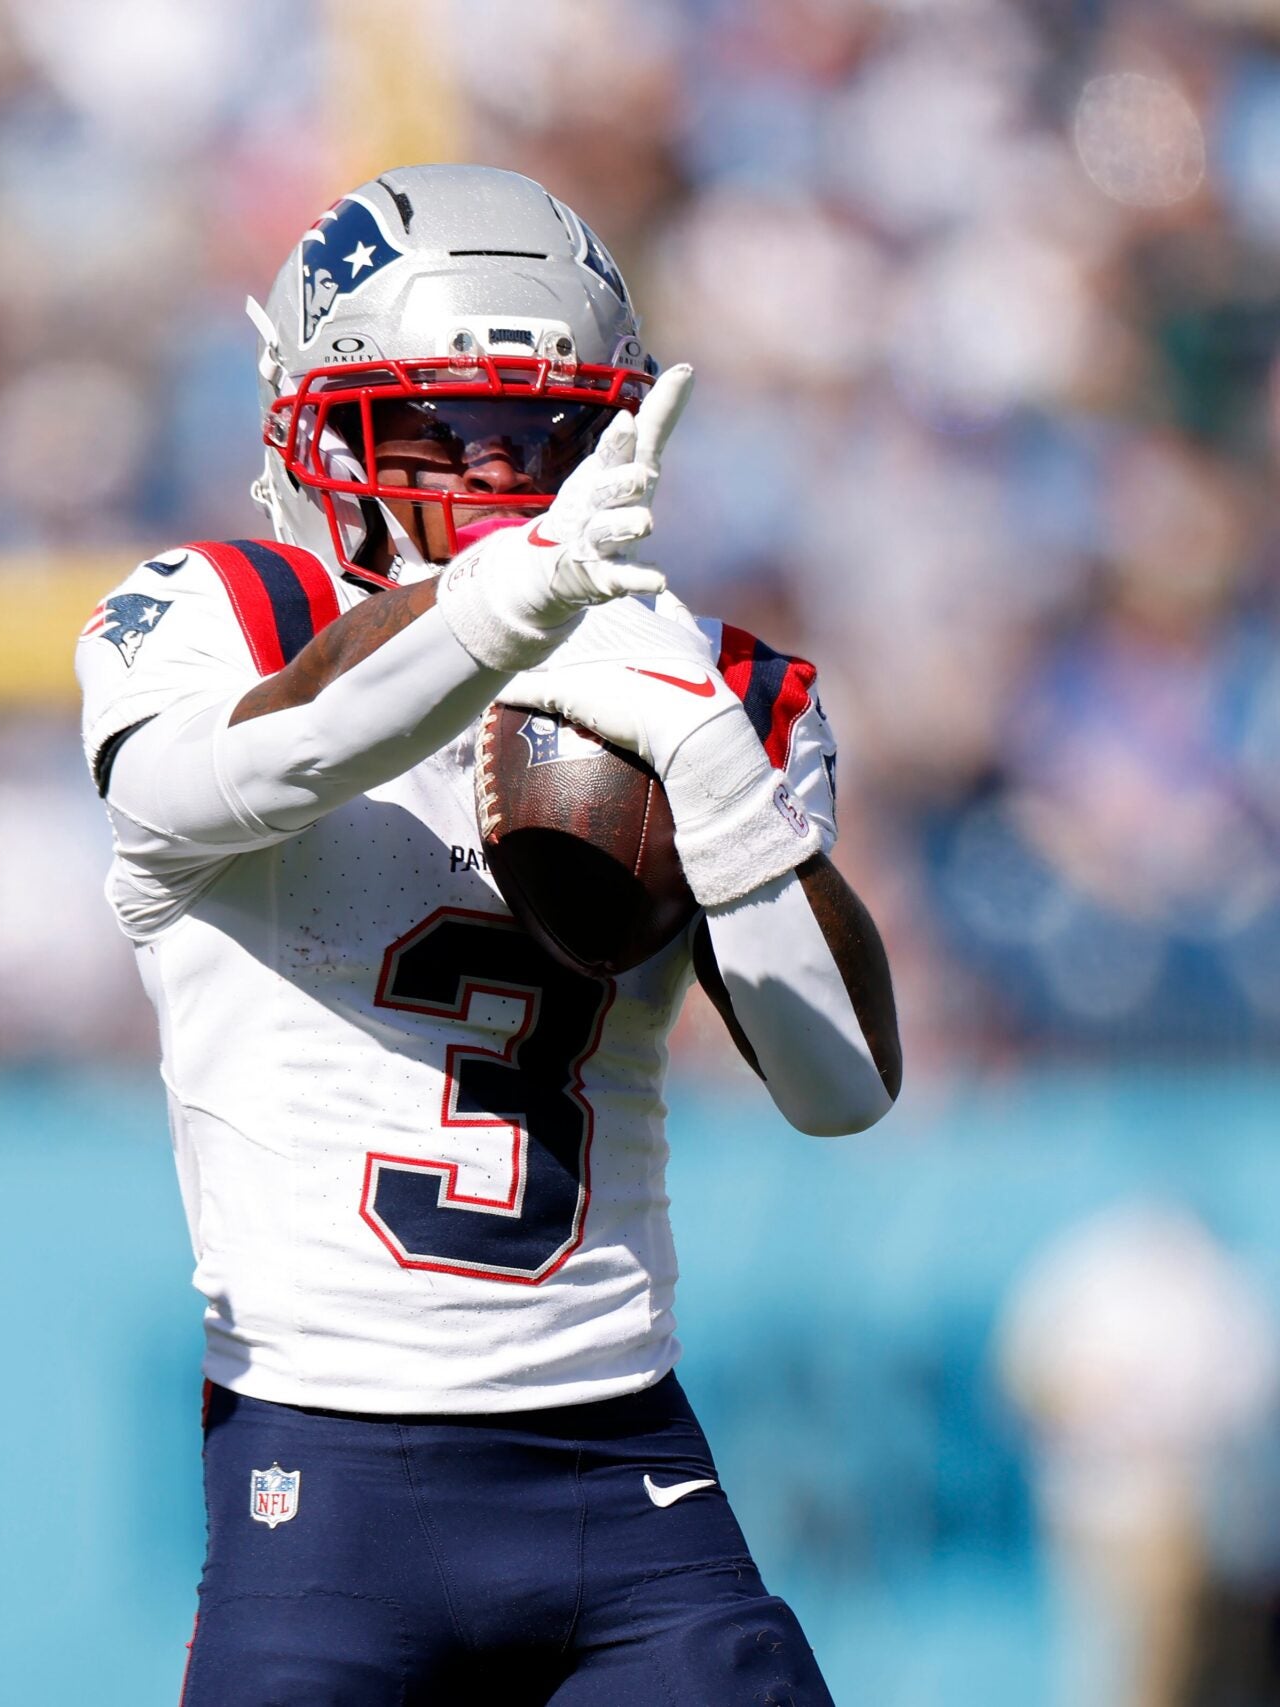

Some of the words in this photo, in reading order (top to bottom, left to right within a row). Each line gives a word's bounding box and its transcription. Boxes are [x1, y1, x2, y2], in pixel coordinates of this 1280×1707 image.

[324, 354, 374, 363] OAKLEY
[450, 844, 488, 873] PAT
[359, 905, 617, 1287] 3
[257, 1493, 290, 1516] NFL
